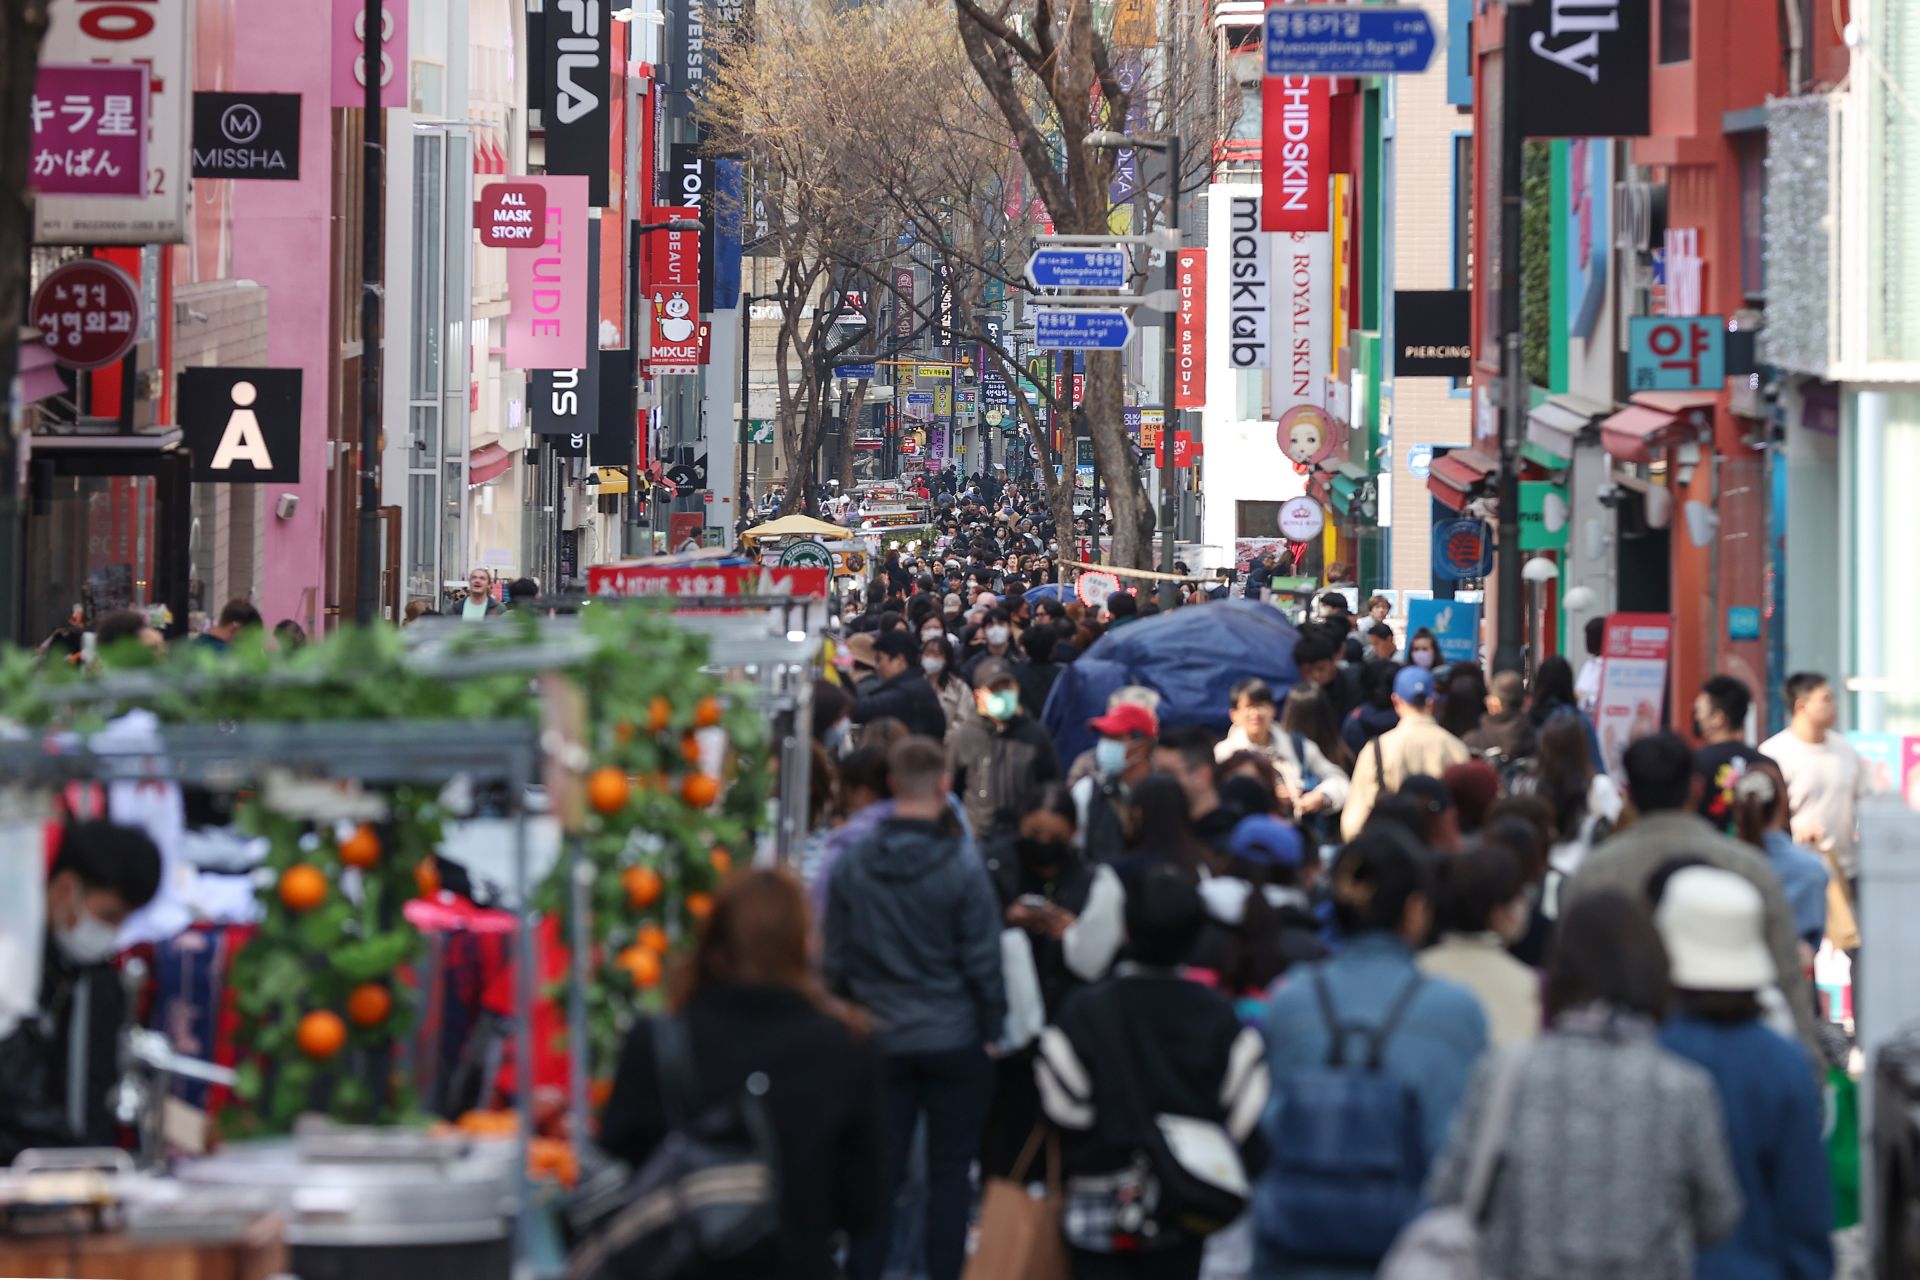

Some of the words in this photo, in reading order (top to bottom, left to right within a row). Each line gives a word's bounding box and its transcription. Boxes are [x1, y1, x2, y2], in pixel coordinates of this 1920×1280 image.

[557, 0, 599, 124] FILA
[34, 149, 121, 177] かばん
[193, 149, 286, 170] MISSHA
[494, 209, 532, 223] MASK
[501, 192, 527, 206] ALL
[492, 226, 533, 239] STORY
[1182, 274, 1192, 324] SUPY
[1232, 198, 1265, 366] masklab
[1293, 254, 1311, 333] ROYAL
[38, 311, 132, 346] 성형외과
[652, 346, 696, 358] MIXUE
[1182, 331, 1192, 395] SEOUL
[1293, 338, 1311, 396] SKIN
[1405, 345, 1471, 358] PIERCING
[1648, 322, 1709, 386] 약
